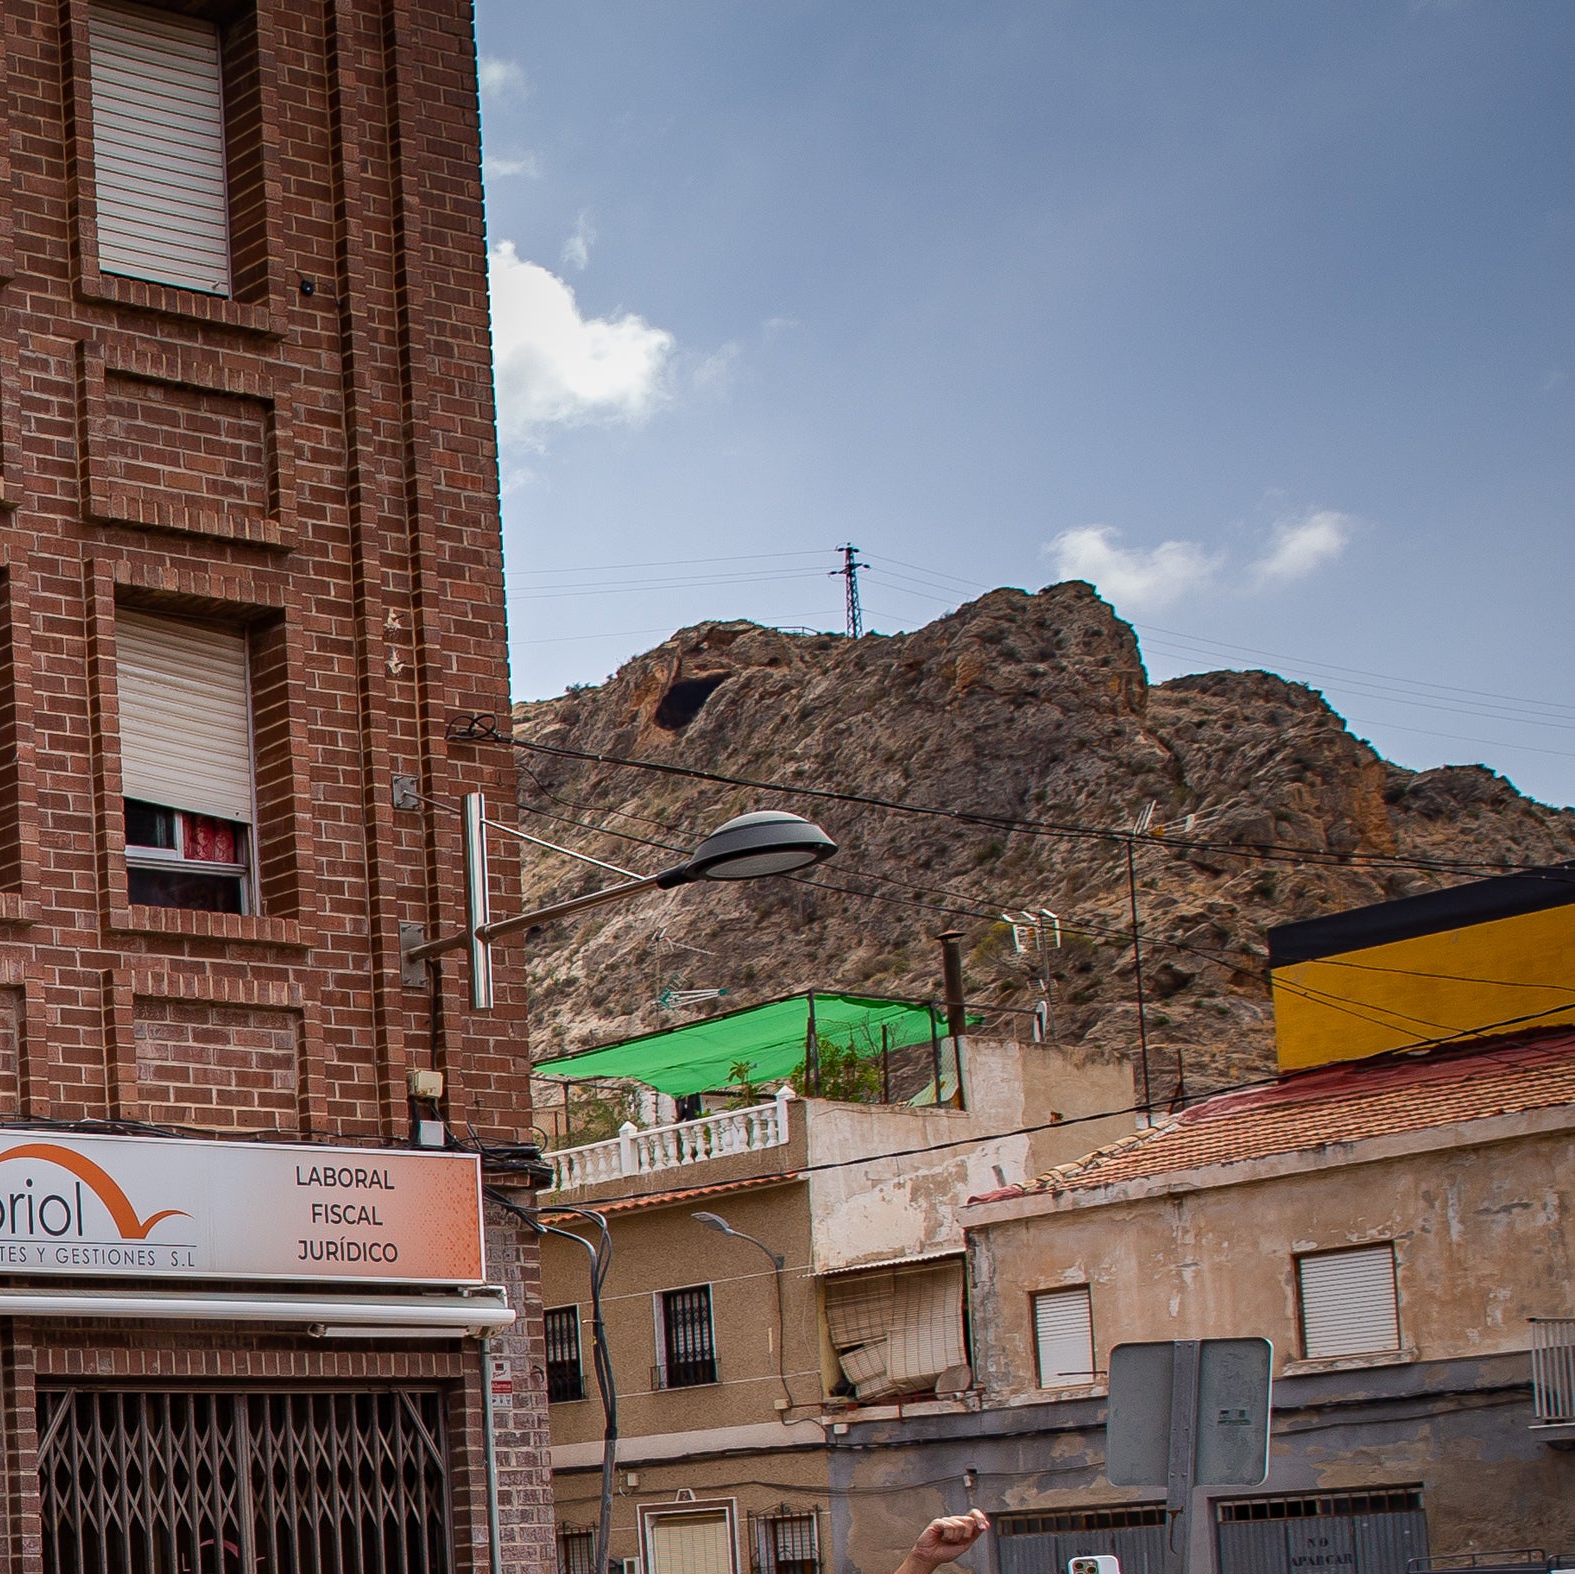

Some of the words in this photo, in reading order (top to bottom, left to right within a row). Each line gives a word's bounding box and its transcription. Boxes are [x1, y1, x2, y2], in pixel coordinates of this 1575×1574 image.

[295, 1165, 395, 1191] LABORAL
[311, 1202, 383, 1227] FISCAL
[37, 1247, 46, 1263] Y
[55, 1247, 156, 1266] GESTIONES
[298, 1236, 398, 1264] JURÍDICO
